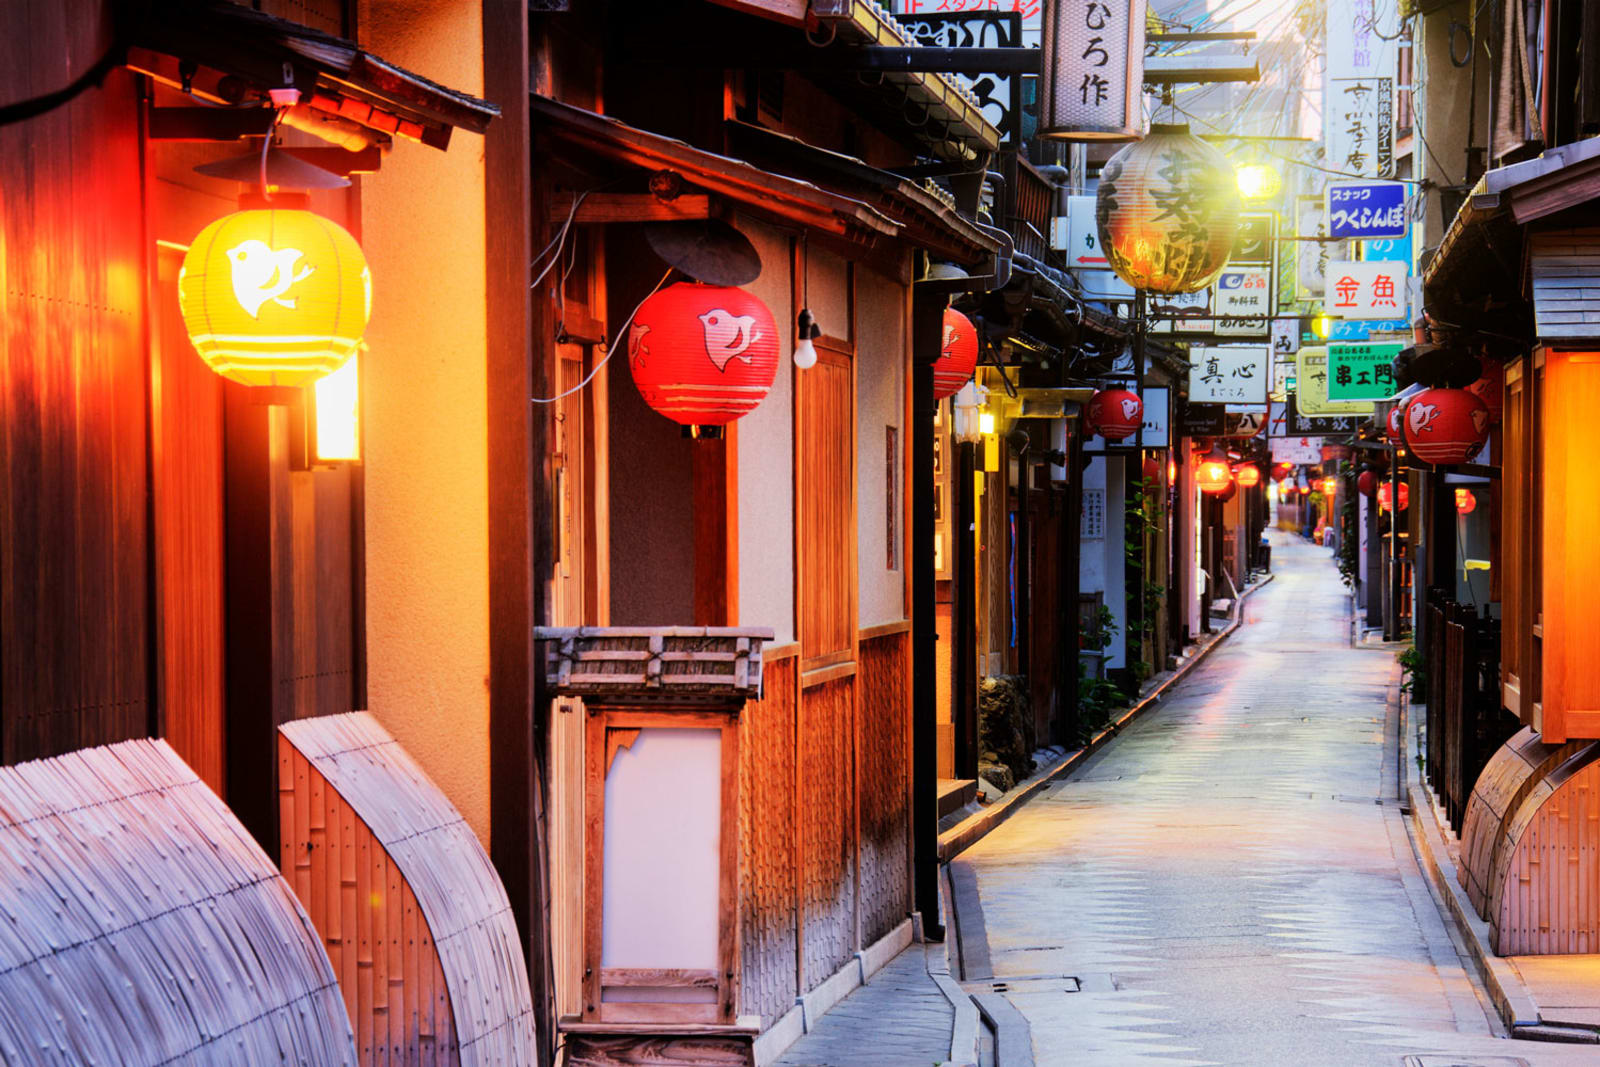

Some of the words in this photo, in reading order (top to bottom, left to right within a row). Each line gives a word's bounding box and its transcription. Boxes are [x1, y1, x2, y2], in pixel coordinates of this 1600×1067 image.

[1080, 3, 1111, 106] ひろ作
[1332, 188, 1371, 201] スナック
[1331, 203, 1404, 229] つくしんぼ
[1334, 274, 1397, 308] 金魚
[1200, 357, 1256, 384] 真心
[1211, 388, 1245, 398] まごころ
